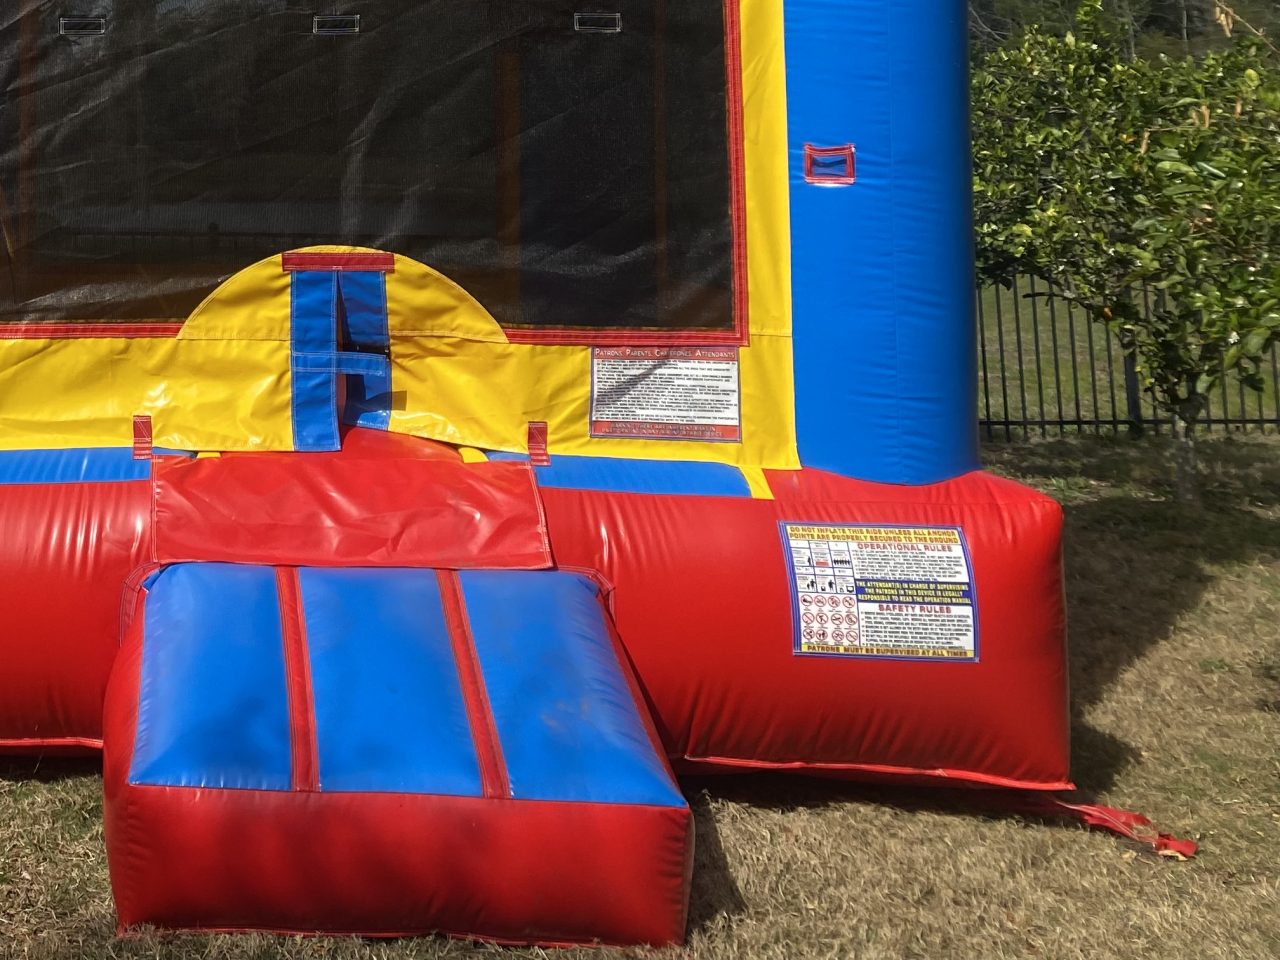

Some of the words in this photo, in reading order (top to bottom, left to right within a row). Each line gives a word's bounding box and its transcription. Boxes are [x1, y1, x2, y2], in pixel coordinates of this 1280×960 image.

[857, 543, 921, 551] OPERATIONAL
[878, 604, 916, 612] SAFETY
[920, 605, 952, 614] RULES
